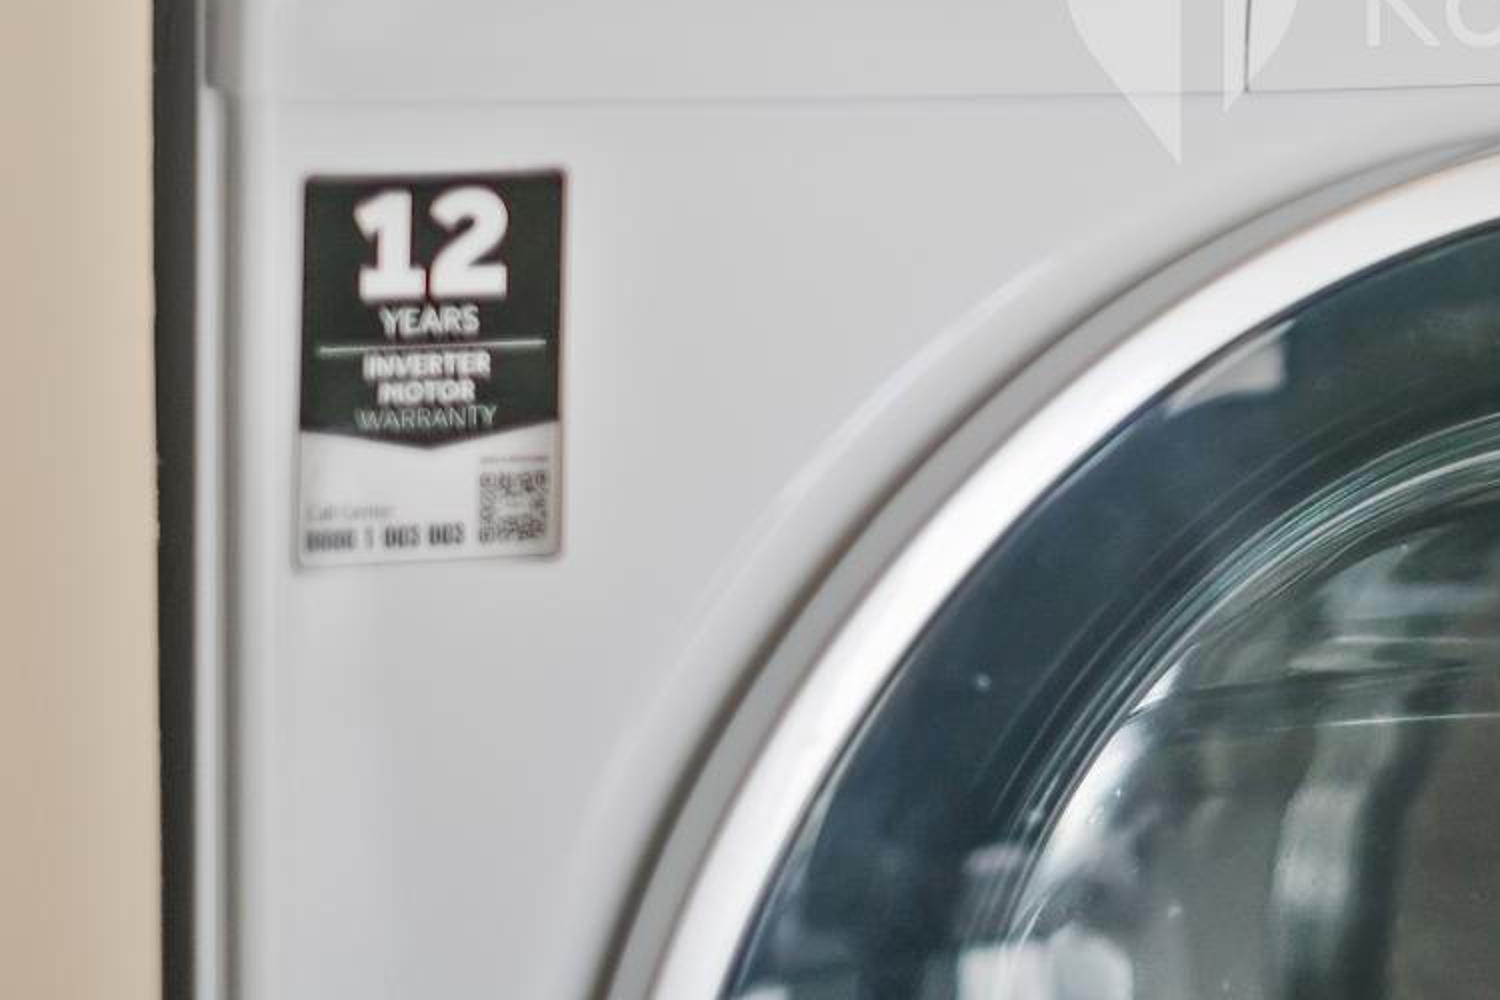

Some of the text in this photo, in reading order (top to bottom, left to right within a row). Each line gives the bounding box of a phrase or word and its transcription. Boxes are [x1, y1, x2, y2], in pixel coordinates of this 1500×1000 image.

[353, 185, 509, 301] 12
[381, 305, 480, 338] YEARS
[363, 351, 491, 379] INVERTER
[376, 379, 476, 406] MOTOR
[355, 406, 497, 430] WARRANTY
